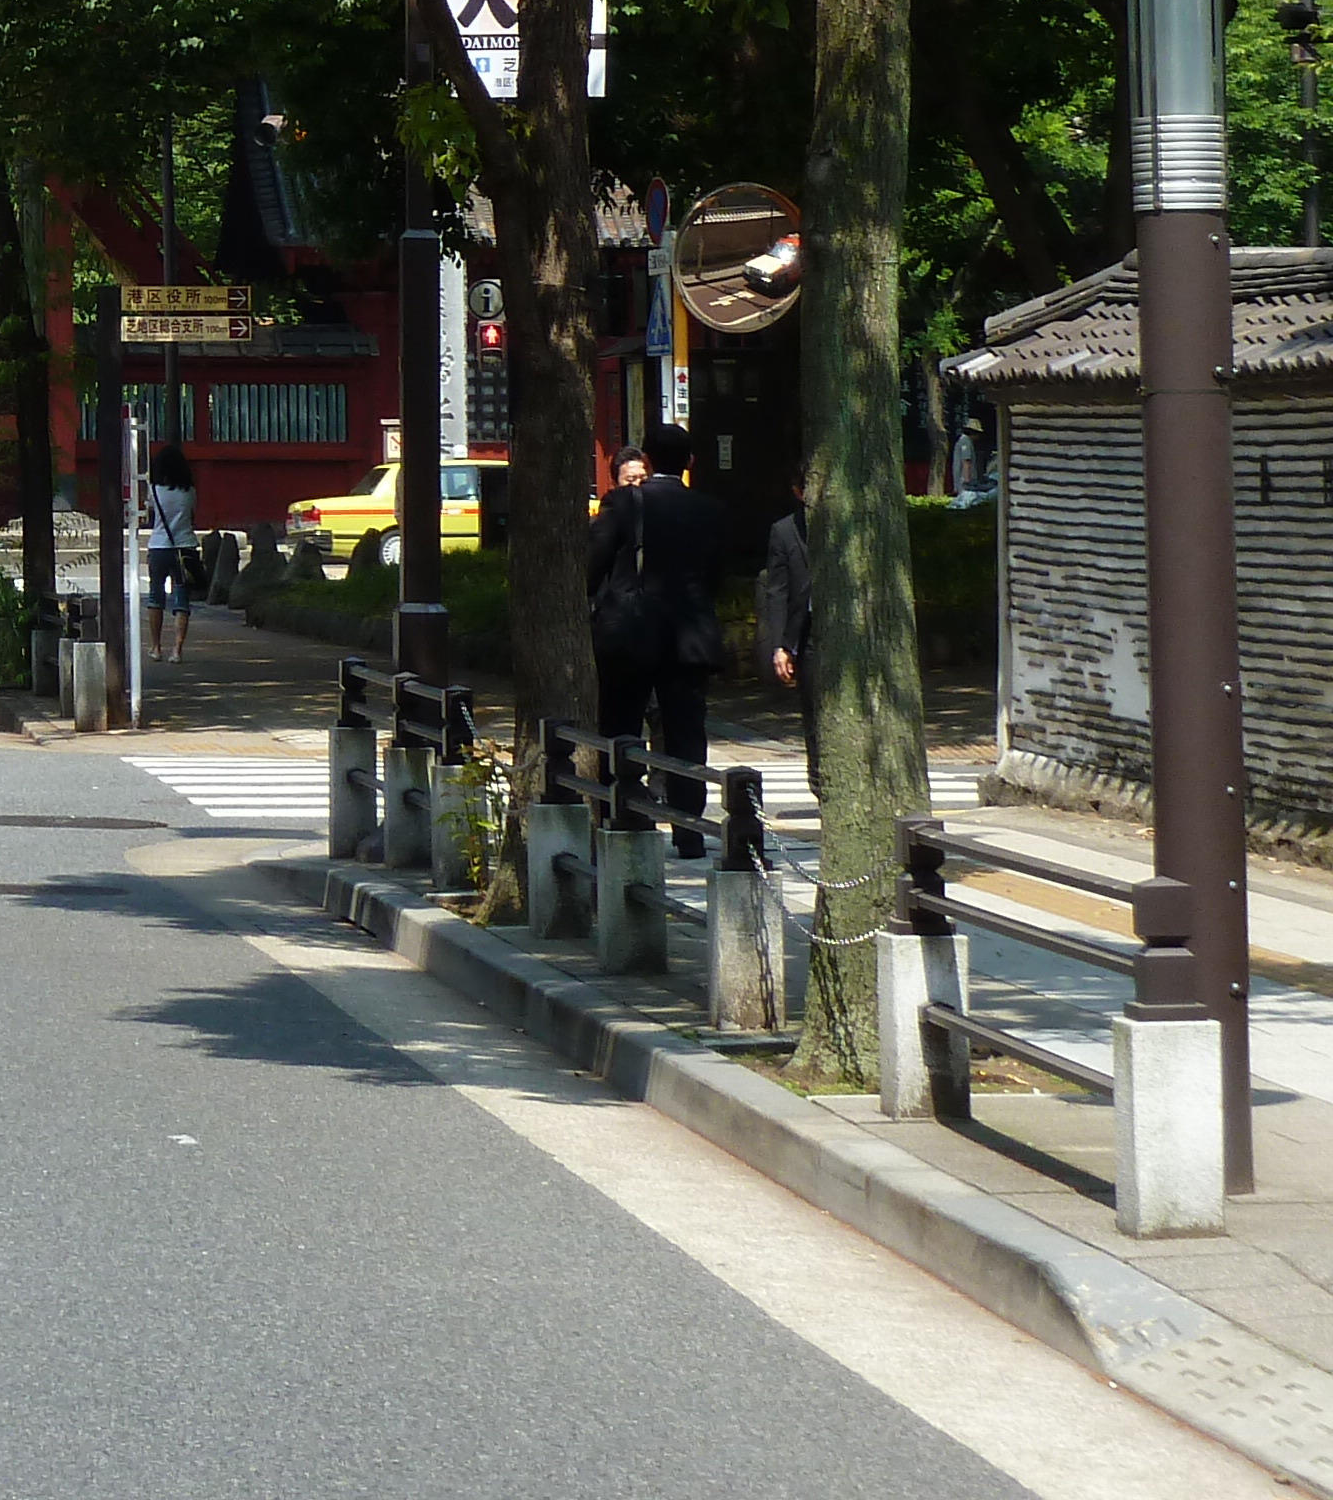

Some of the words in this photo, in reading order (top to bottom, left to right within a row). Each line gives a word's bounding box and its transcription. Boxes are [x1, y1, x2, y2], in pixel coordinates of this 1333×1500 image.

[462, 36, 520, 49] DAIMO
[128, 289, 201, 304] 港区役所
[126, 319, 204, 334] 芝地区総合支所
